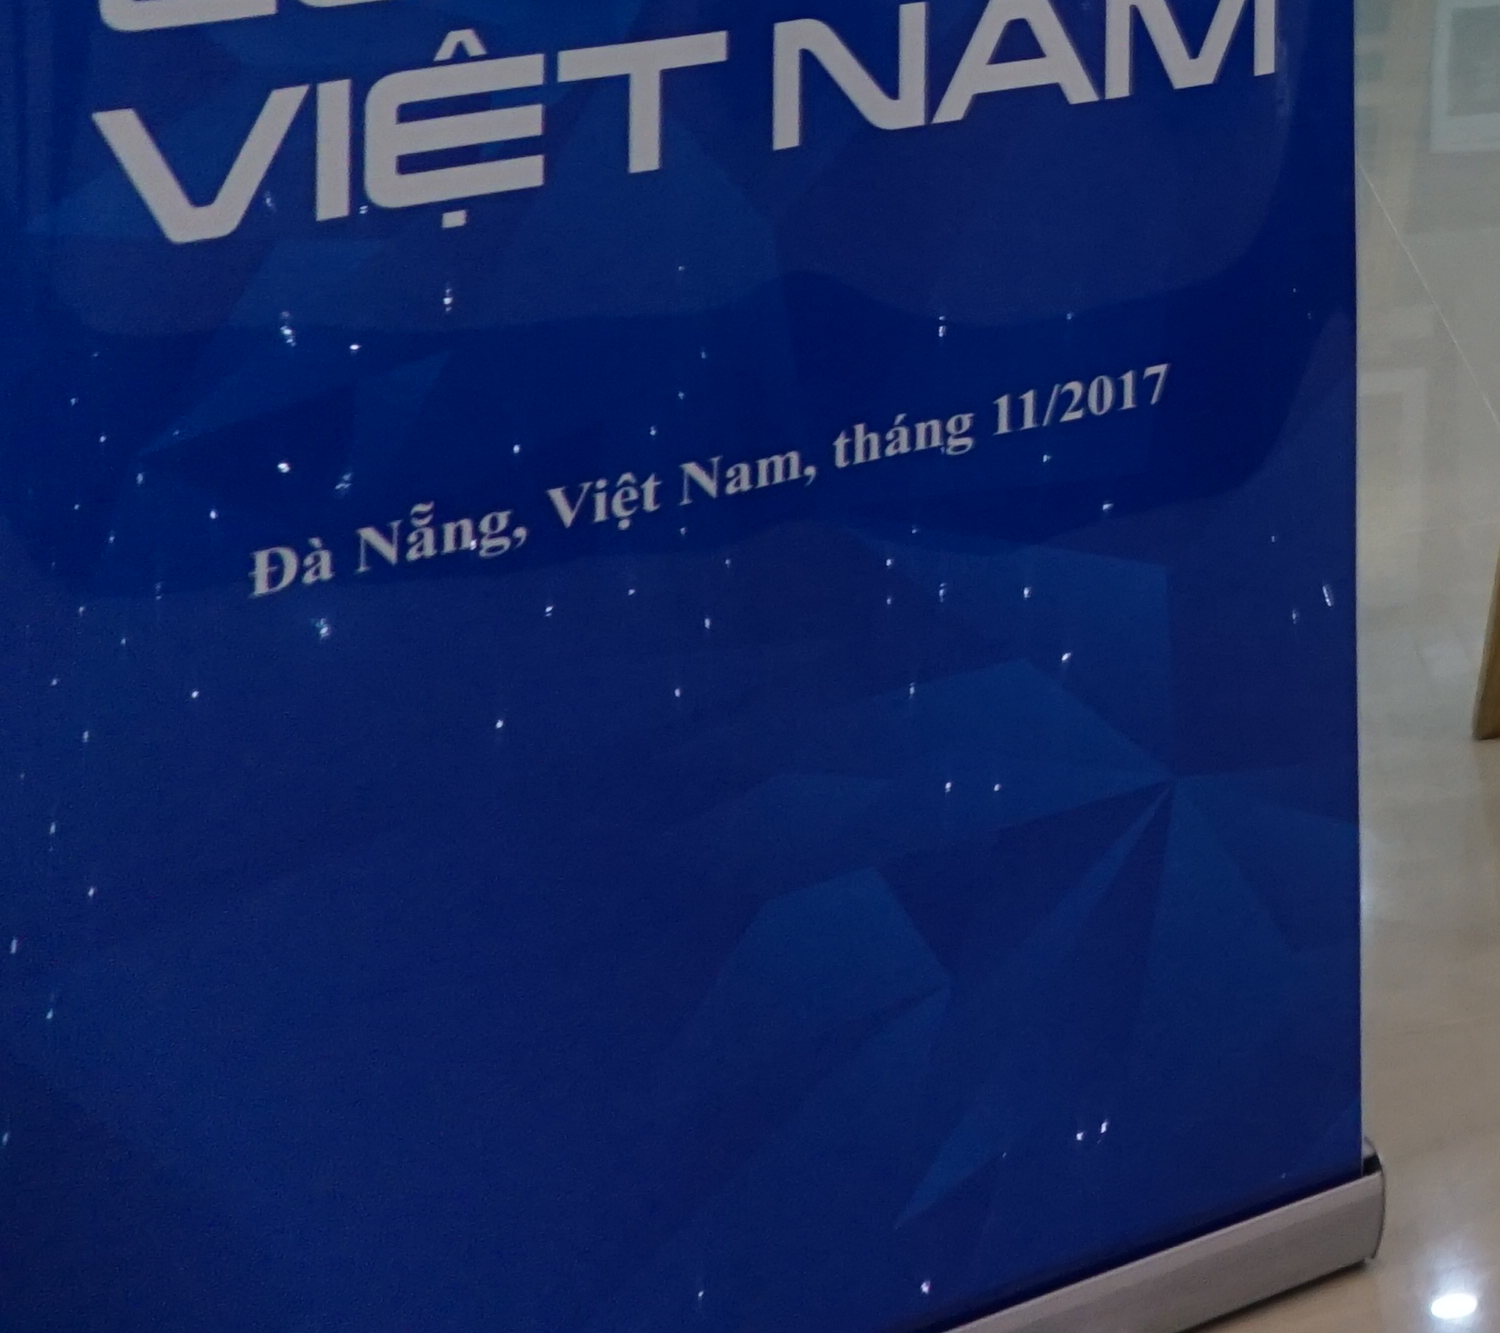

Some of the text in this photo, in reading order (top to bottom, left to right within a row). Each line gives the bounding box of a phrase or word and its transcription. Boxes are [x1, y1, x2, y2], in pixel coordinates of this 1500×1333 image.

[91, 29, 729, 245] VIỆT
[247, 362, 1172, 599] Đà Nẵng, Việt Nam, tháng 11/2017
